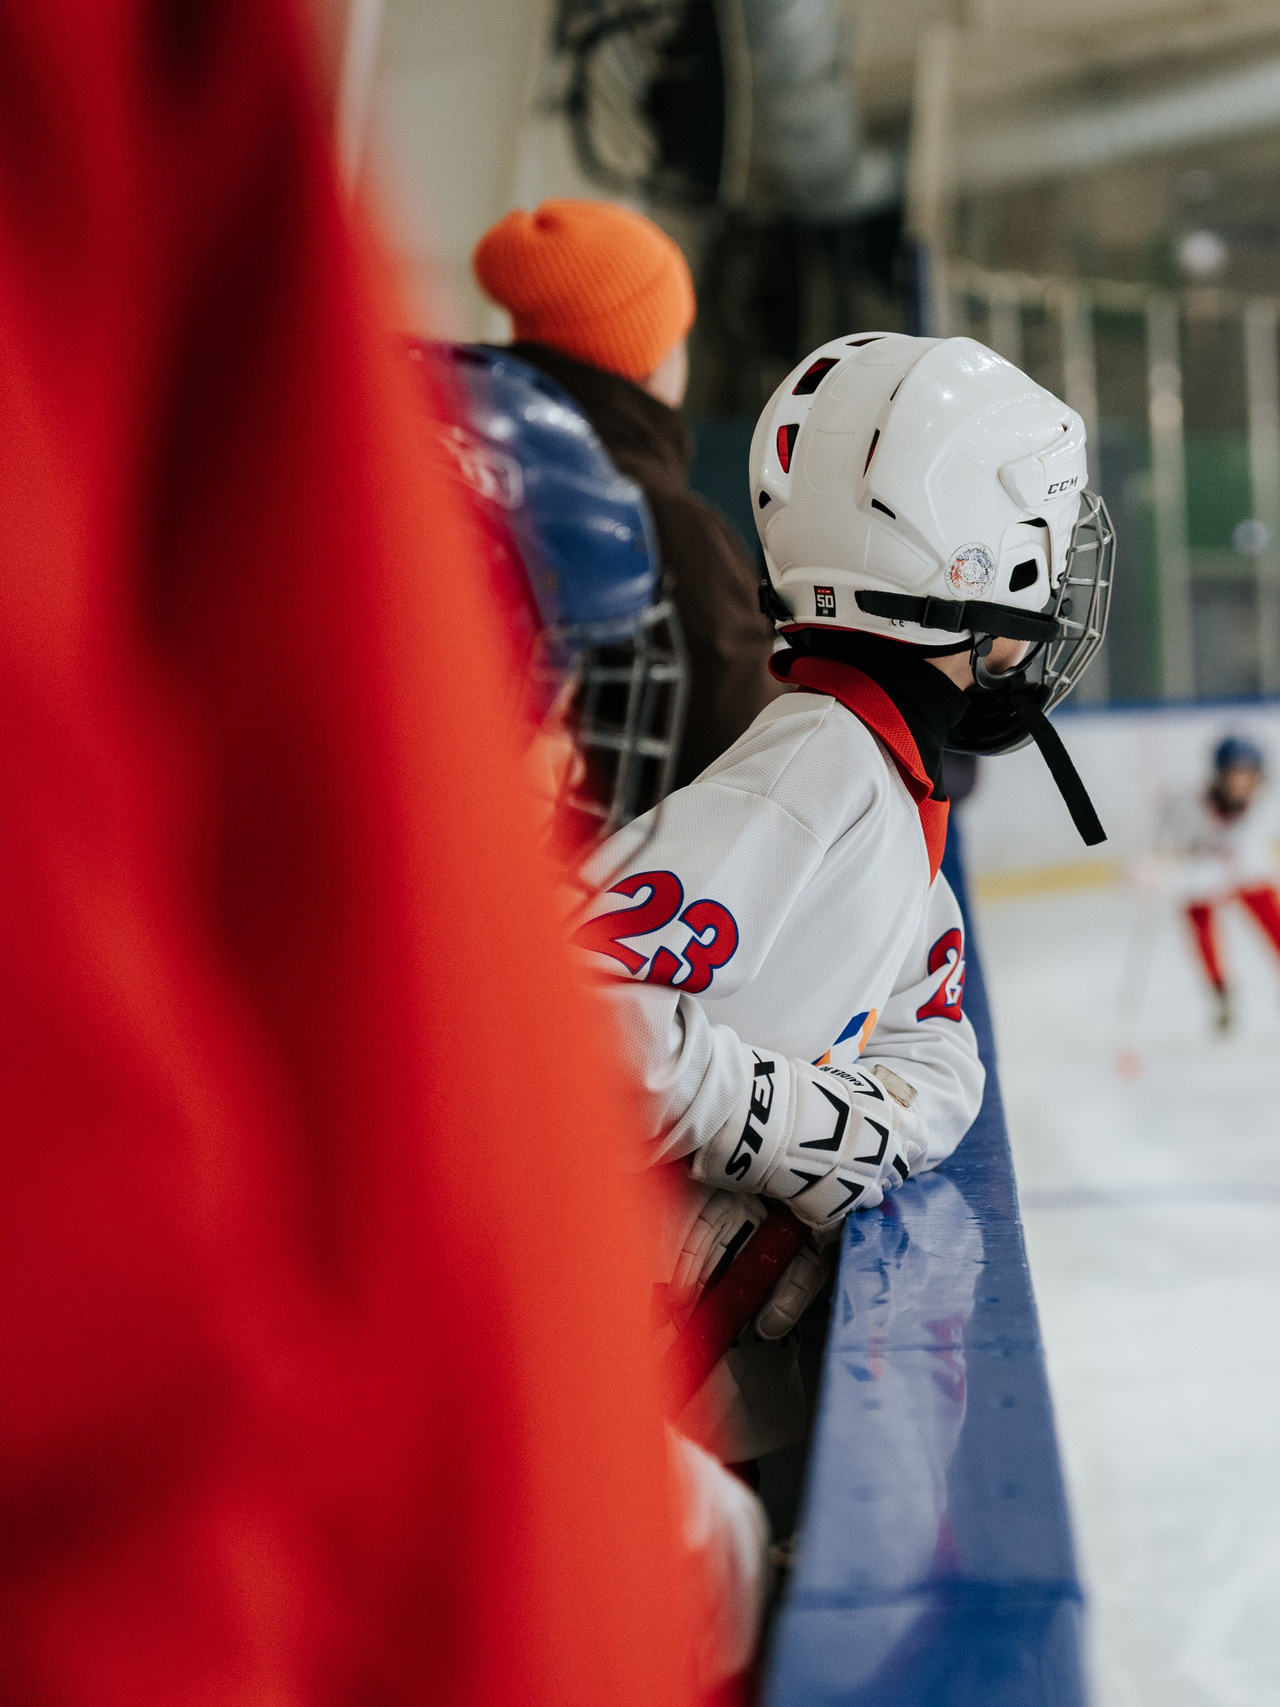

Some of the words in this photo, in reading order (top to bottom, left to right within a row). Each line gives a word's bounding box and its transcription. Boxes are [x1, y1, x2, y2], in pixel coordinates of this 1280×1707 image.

[1047, 475, 1079, 495] CCM
[816, 594, 834, 608] 50
[567, 870, 740, 994] 23
[916, 927, 966, 1023] 2
[830, 1068, 865, 1087] RAIDER
